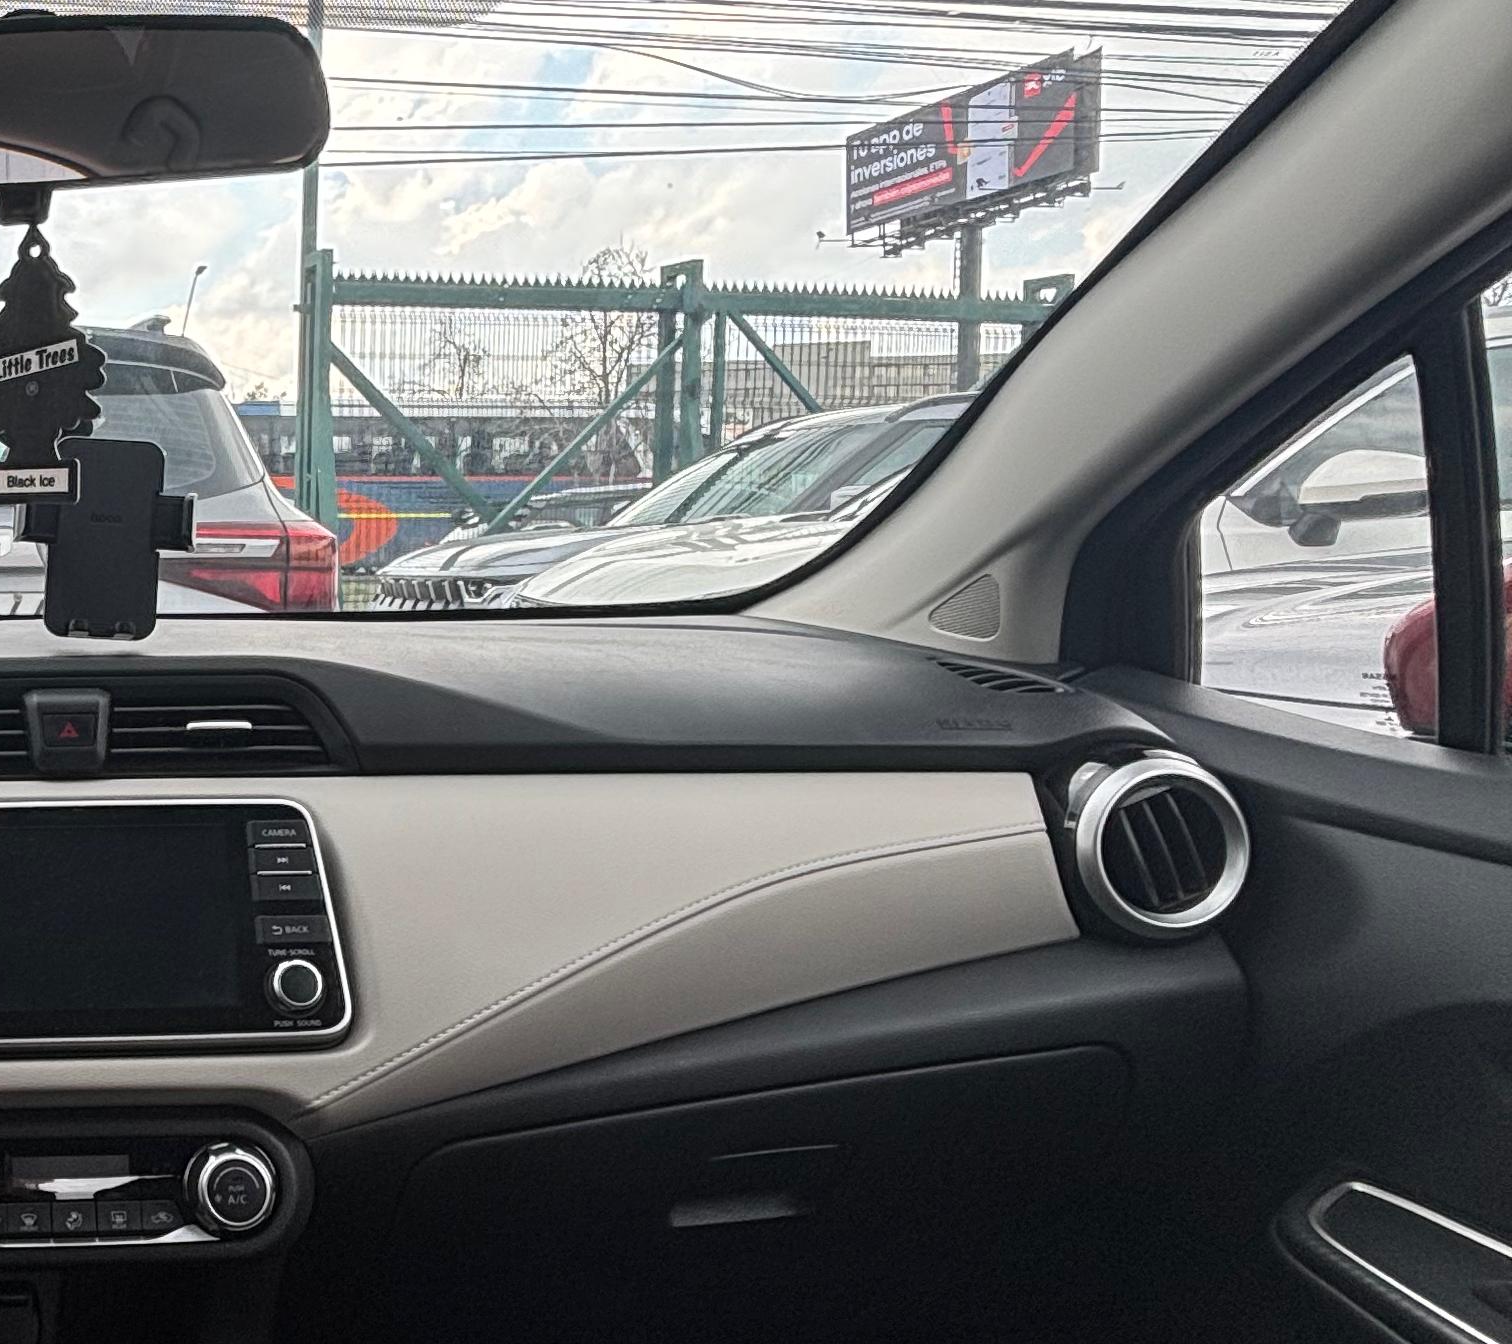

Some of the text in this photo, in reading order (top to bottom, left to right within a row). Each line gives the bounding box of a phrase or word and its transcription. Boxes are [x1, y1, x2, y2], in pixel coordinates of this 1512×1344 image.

[902, 119, 924, 141] de
[850, 144, 937, 185] inversiones
[35, 347, 75, 370] Trees
[7, 474, 56, 488] Black Ice
[261, 828, 297, 837] CAMERA
[284, 925, 309, 934] BACK
[227, 1194, 248, 1205] A/C
